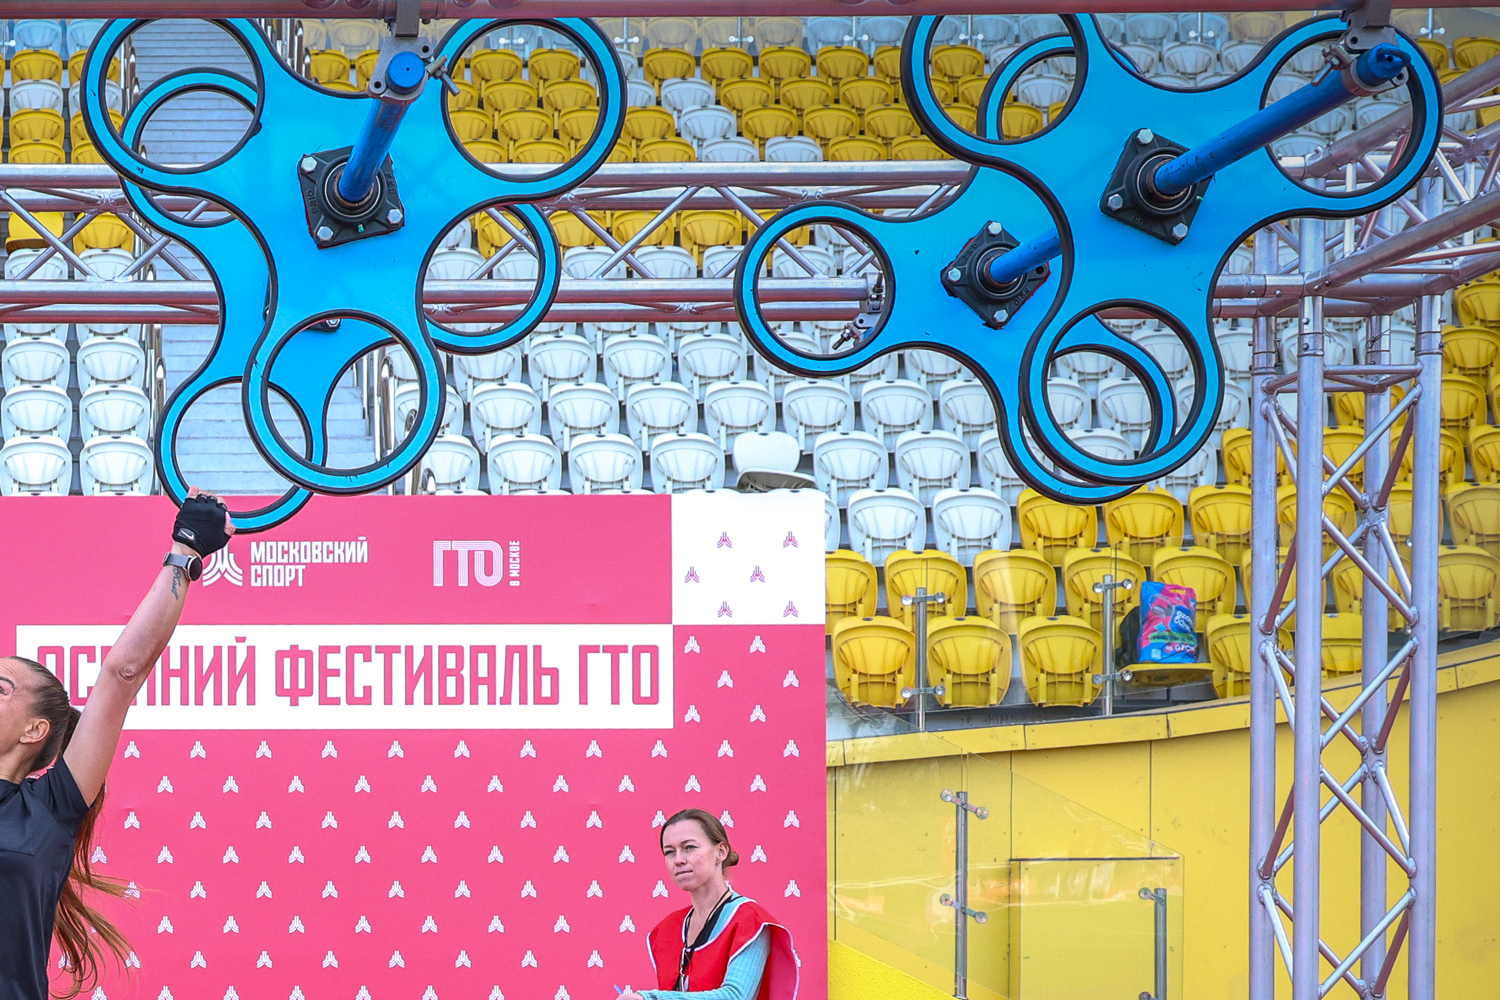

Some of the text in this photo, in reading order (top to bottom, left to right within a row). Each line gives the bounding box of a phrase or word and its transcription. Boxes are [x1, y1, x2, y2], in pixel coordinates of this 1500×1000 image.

[250, 536, 368, 563] МОСКОВСКИЙ
[433, 540, 504, 587] ГТО
[509, 540, 520, 577] МОСКВЕ
[250, 564, 306, 587] СПОРТ
[37, 636, 660, 706] ОСНИЙ ФЕСТИВАЛЬ ГТО
